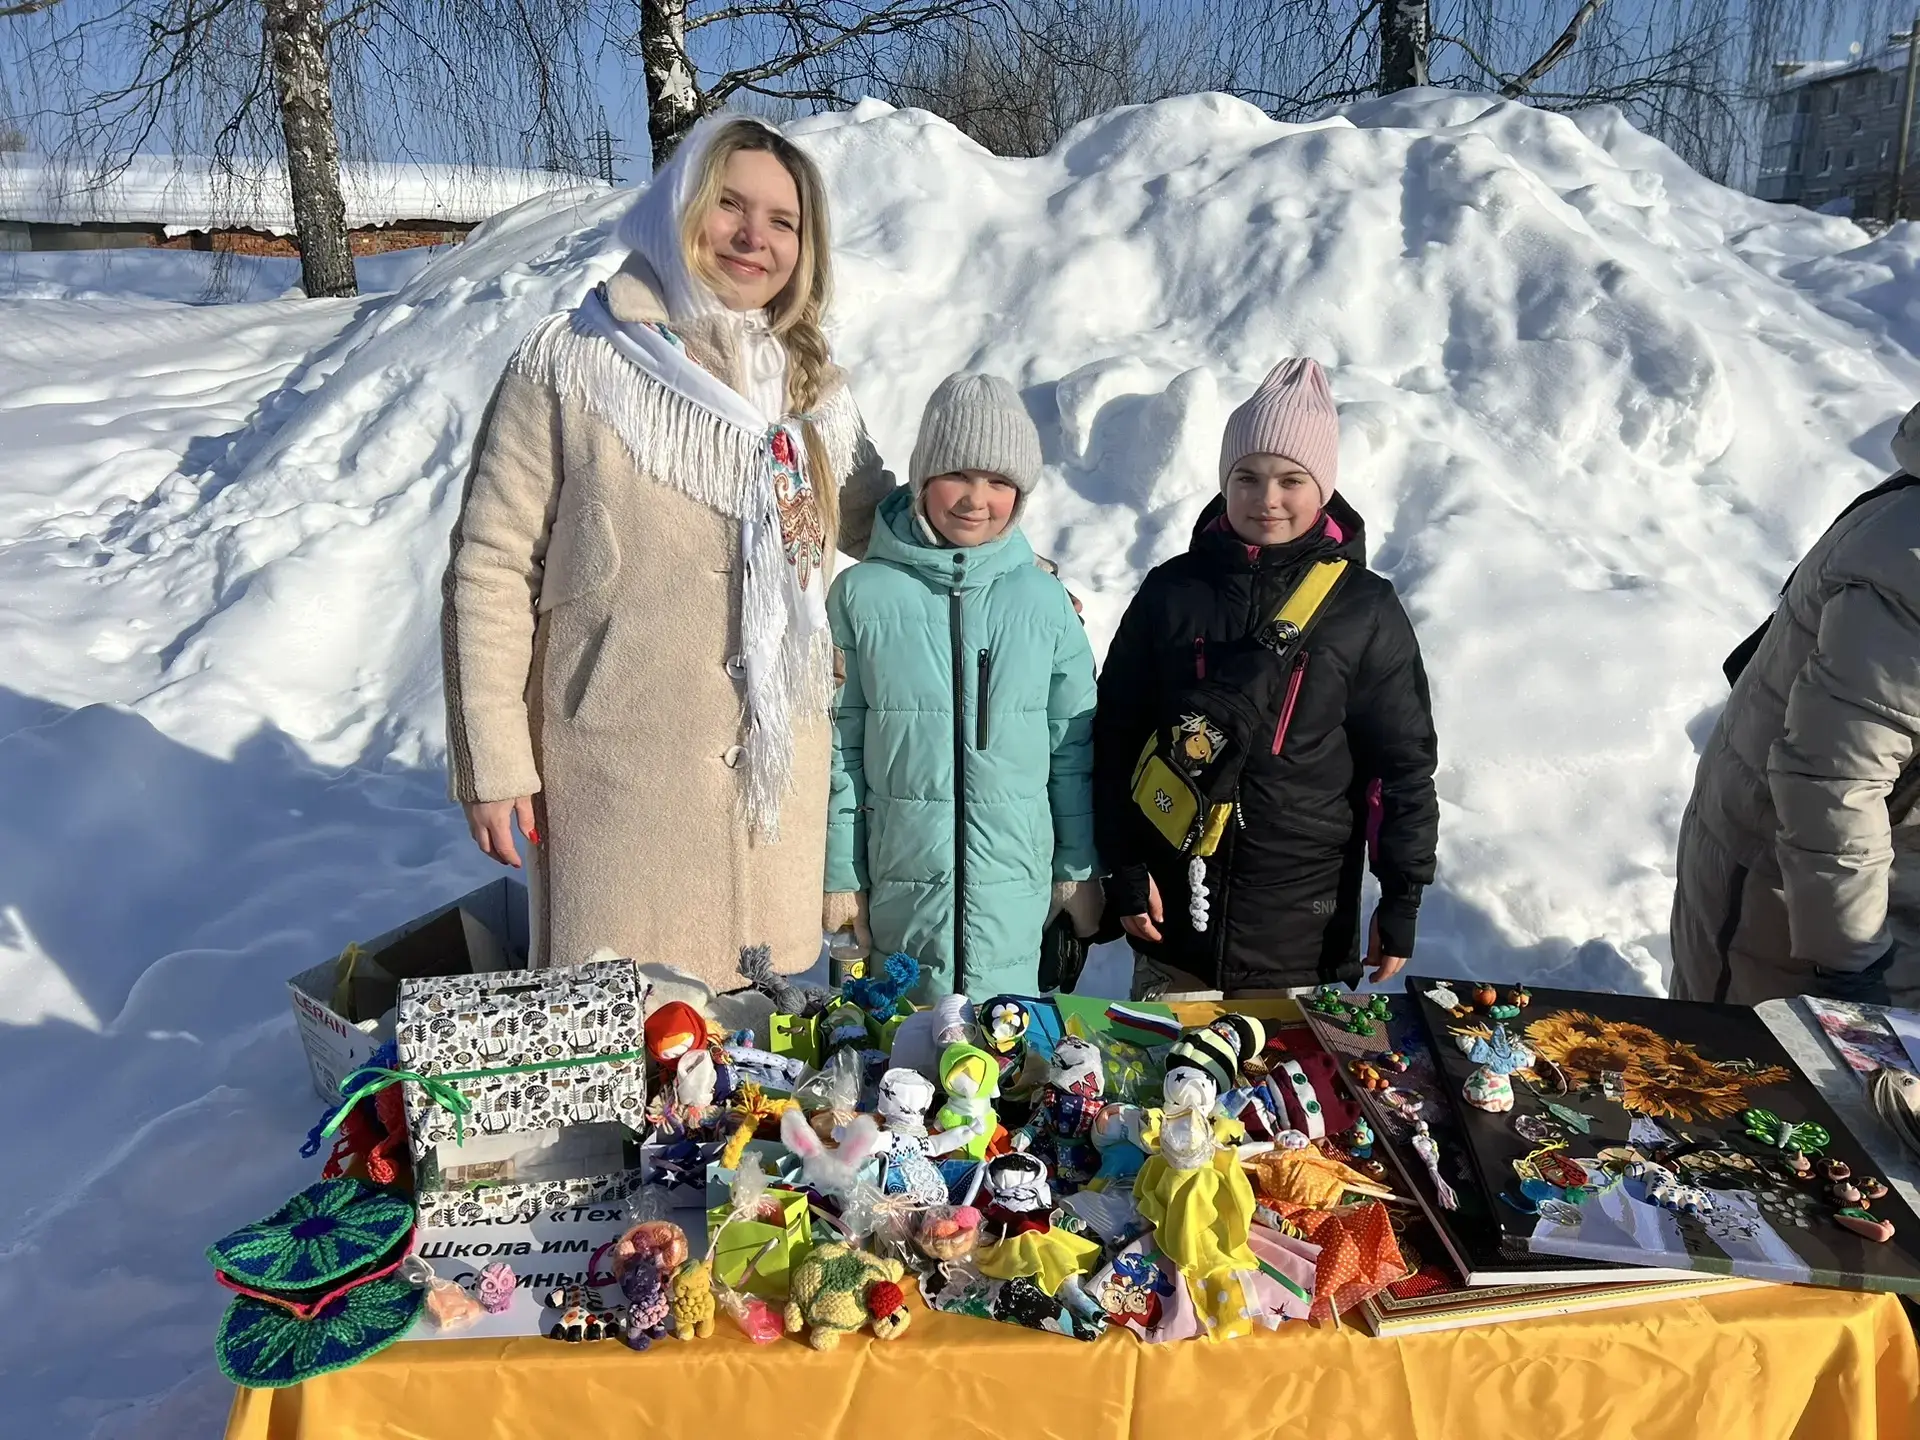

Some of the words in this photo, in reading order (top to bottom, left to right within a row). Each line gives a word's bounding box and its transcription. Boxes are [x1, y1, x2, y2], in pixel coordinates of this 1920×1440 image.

[294, 991, 347, 1039] LERAN
[419, 1241, 531, 1258] Школа
[541, 1239, 597, 1254] им.
